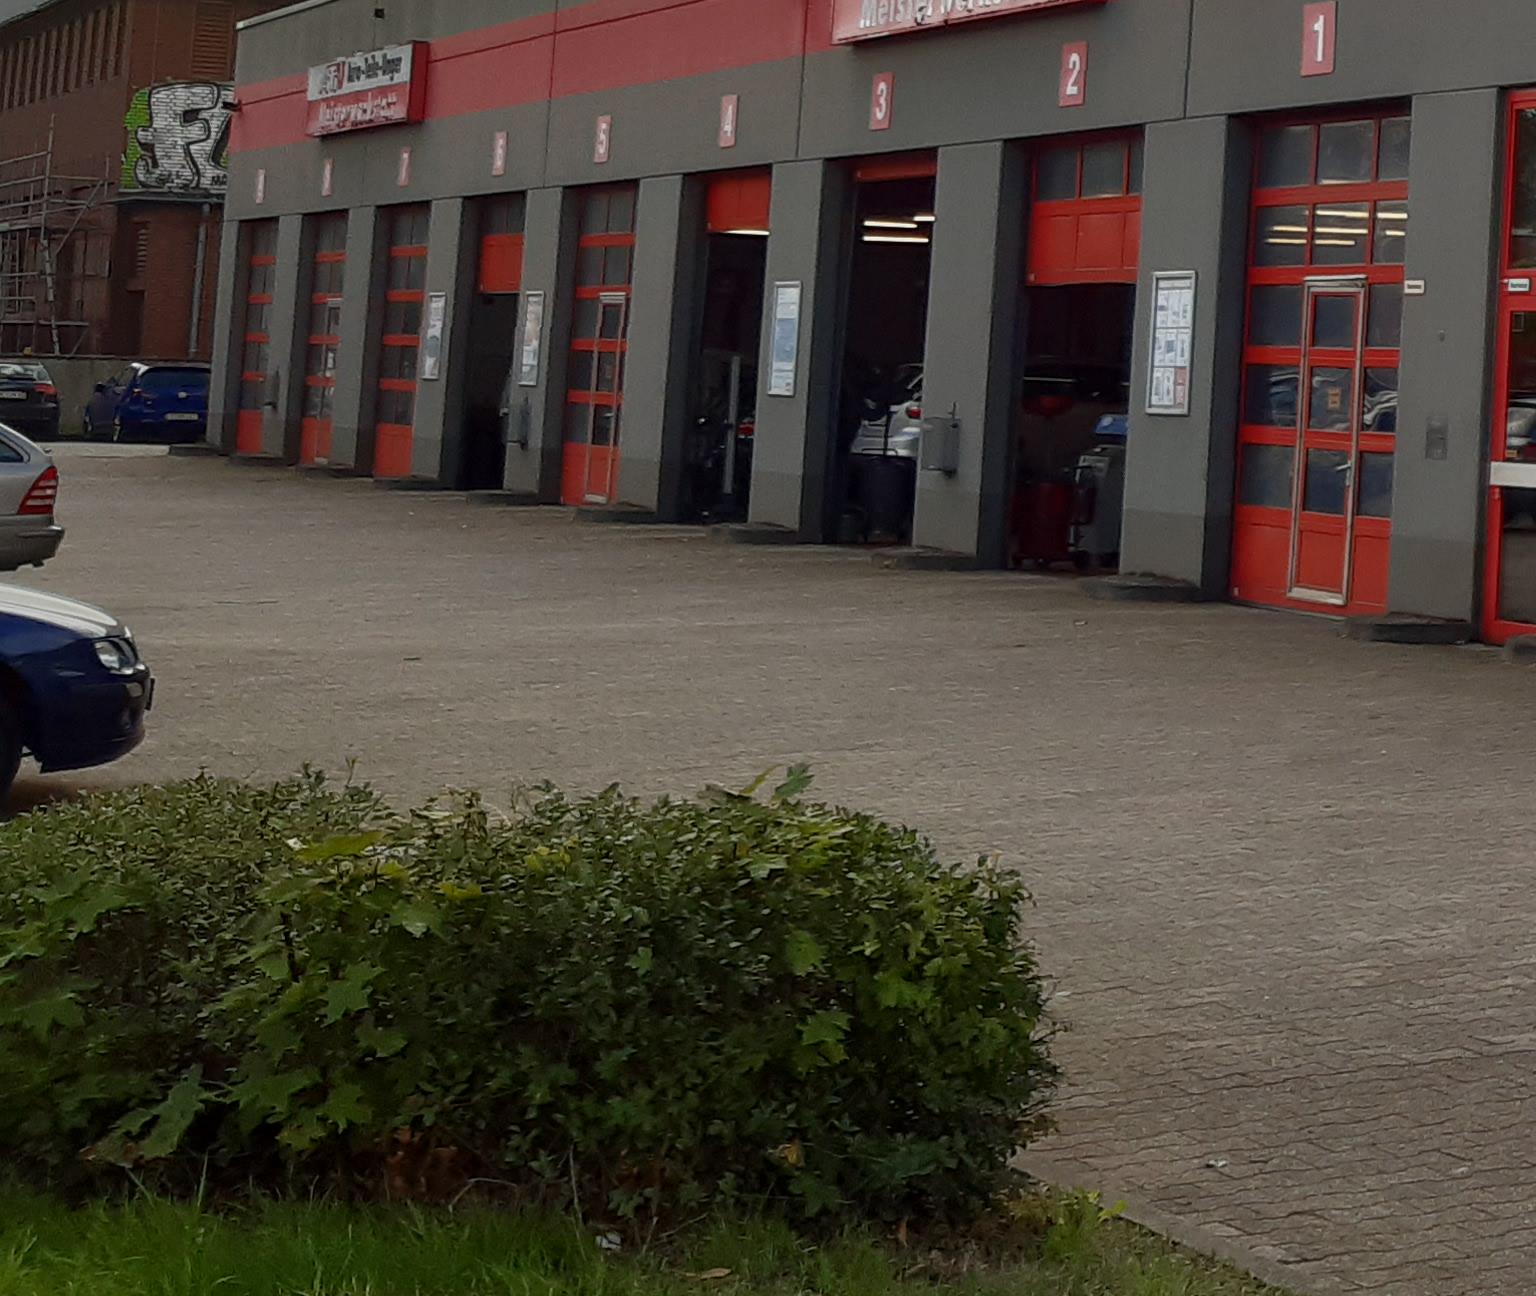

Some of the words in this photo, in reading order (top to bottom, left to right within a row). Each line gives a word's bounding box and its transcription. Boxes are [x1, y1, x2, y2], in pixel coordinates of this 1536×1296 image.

[1312, 14, 1324, 62] 1
[1066, 52, 1081, 95] 2
[723, 103, 733, 138] 4
[875, 80, 888, 121] 3
[598, 121, 609, 155] 5
